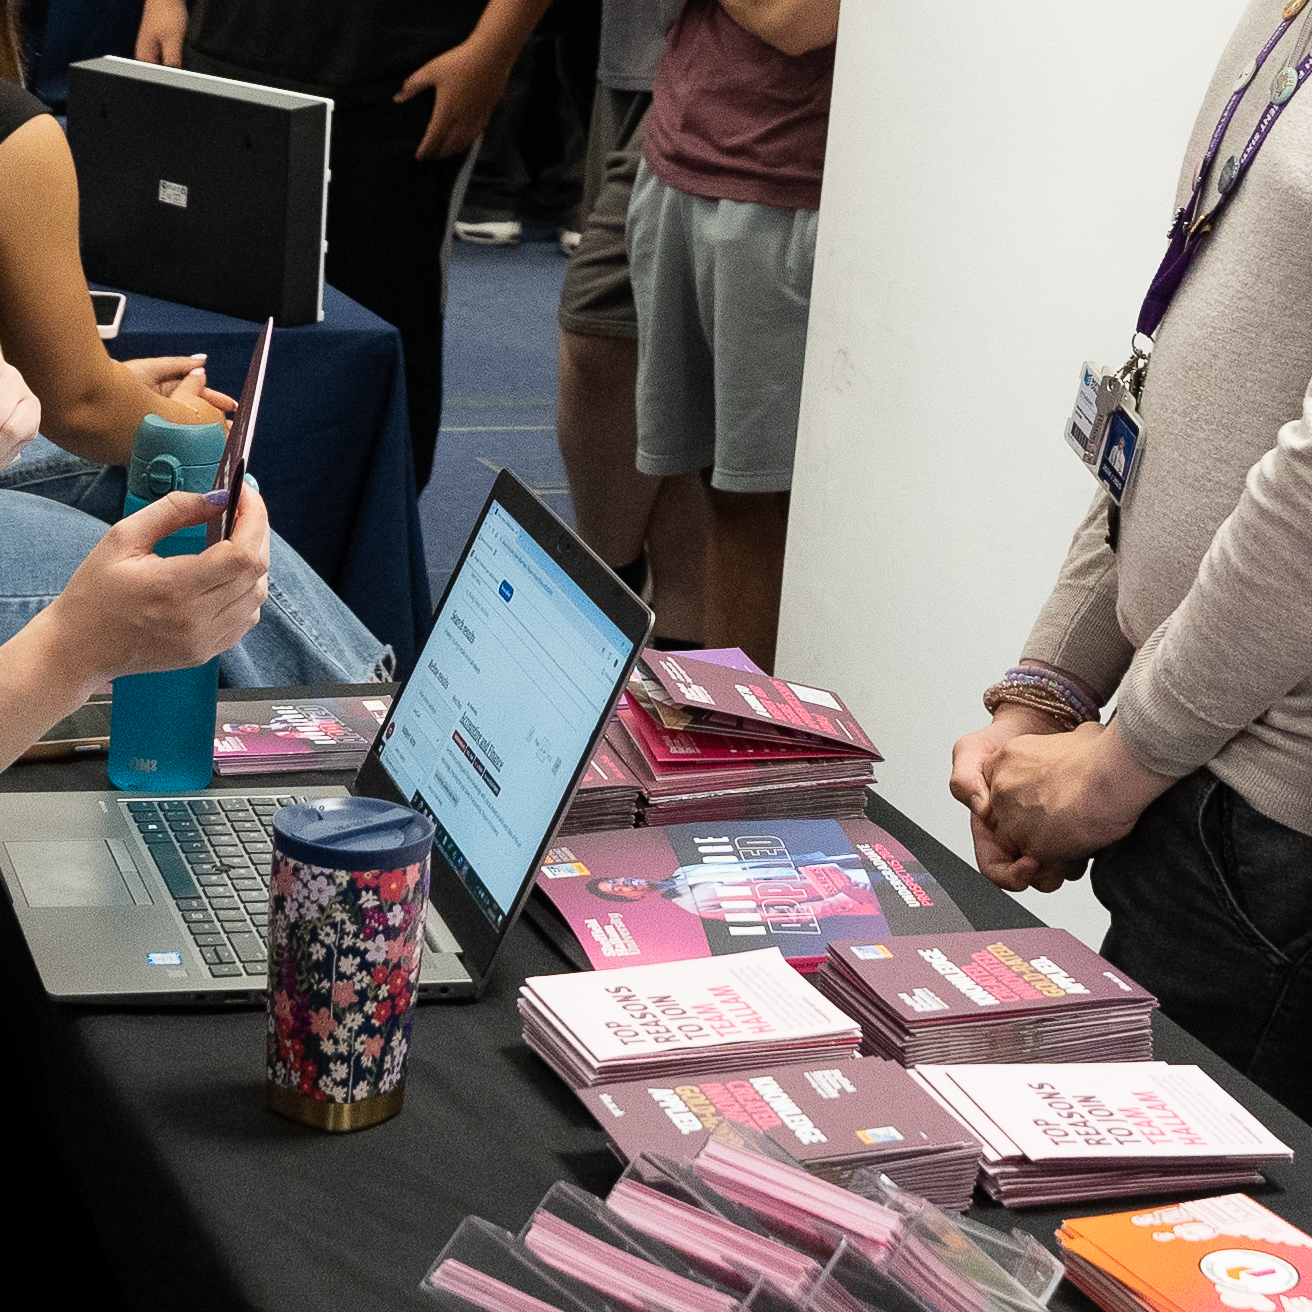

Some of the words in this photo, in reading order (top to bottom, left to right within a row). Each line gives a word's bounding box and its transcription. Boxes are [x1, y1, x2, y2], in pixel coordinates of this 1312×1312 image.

[856, 843, 921, 908] UNDERGRADUATE
[887, 859, 934, 908] PROSPECTUS
[917, 947, 1001, 1006] KNOWLEDGE
[604, 985, 681, 1044] REASONS
[648, 995, 699, 1020] JOIN
[690, 1003, 742, 1037] TEAM
[707, 985, 777, 1034] HALLAM
[605, 1021, 653, 1046] TOP
[677, 1022, 711, 1041] TO
[648, 1088, 703, 1135] APPLIED.
[749, 1075, 828, 1145] KNOWLEDGE
[1027, 1082, 1112, 1146] REASONS
[1033, 1118, 1077, 1145] TOP
[1072, 1095, 1128, 1122] JOIN
[1117, 1107, 1173, 1145] TEAM
[1131, 1091, 1207, 1145] HALLAM
[1106, 1126, 1141, 1145] TO
